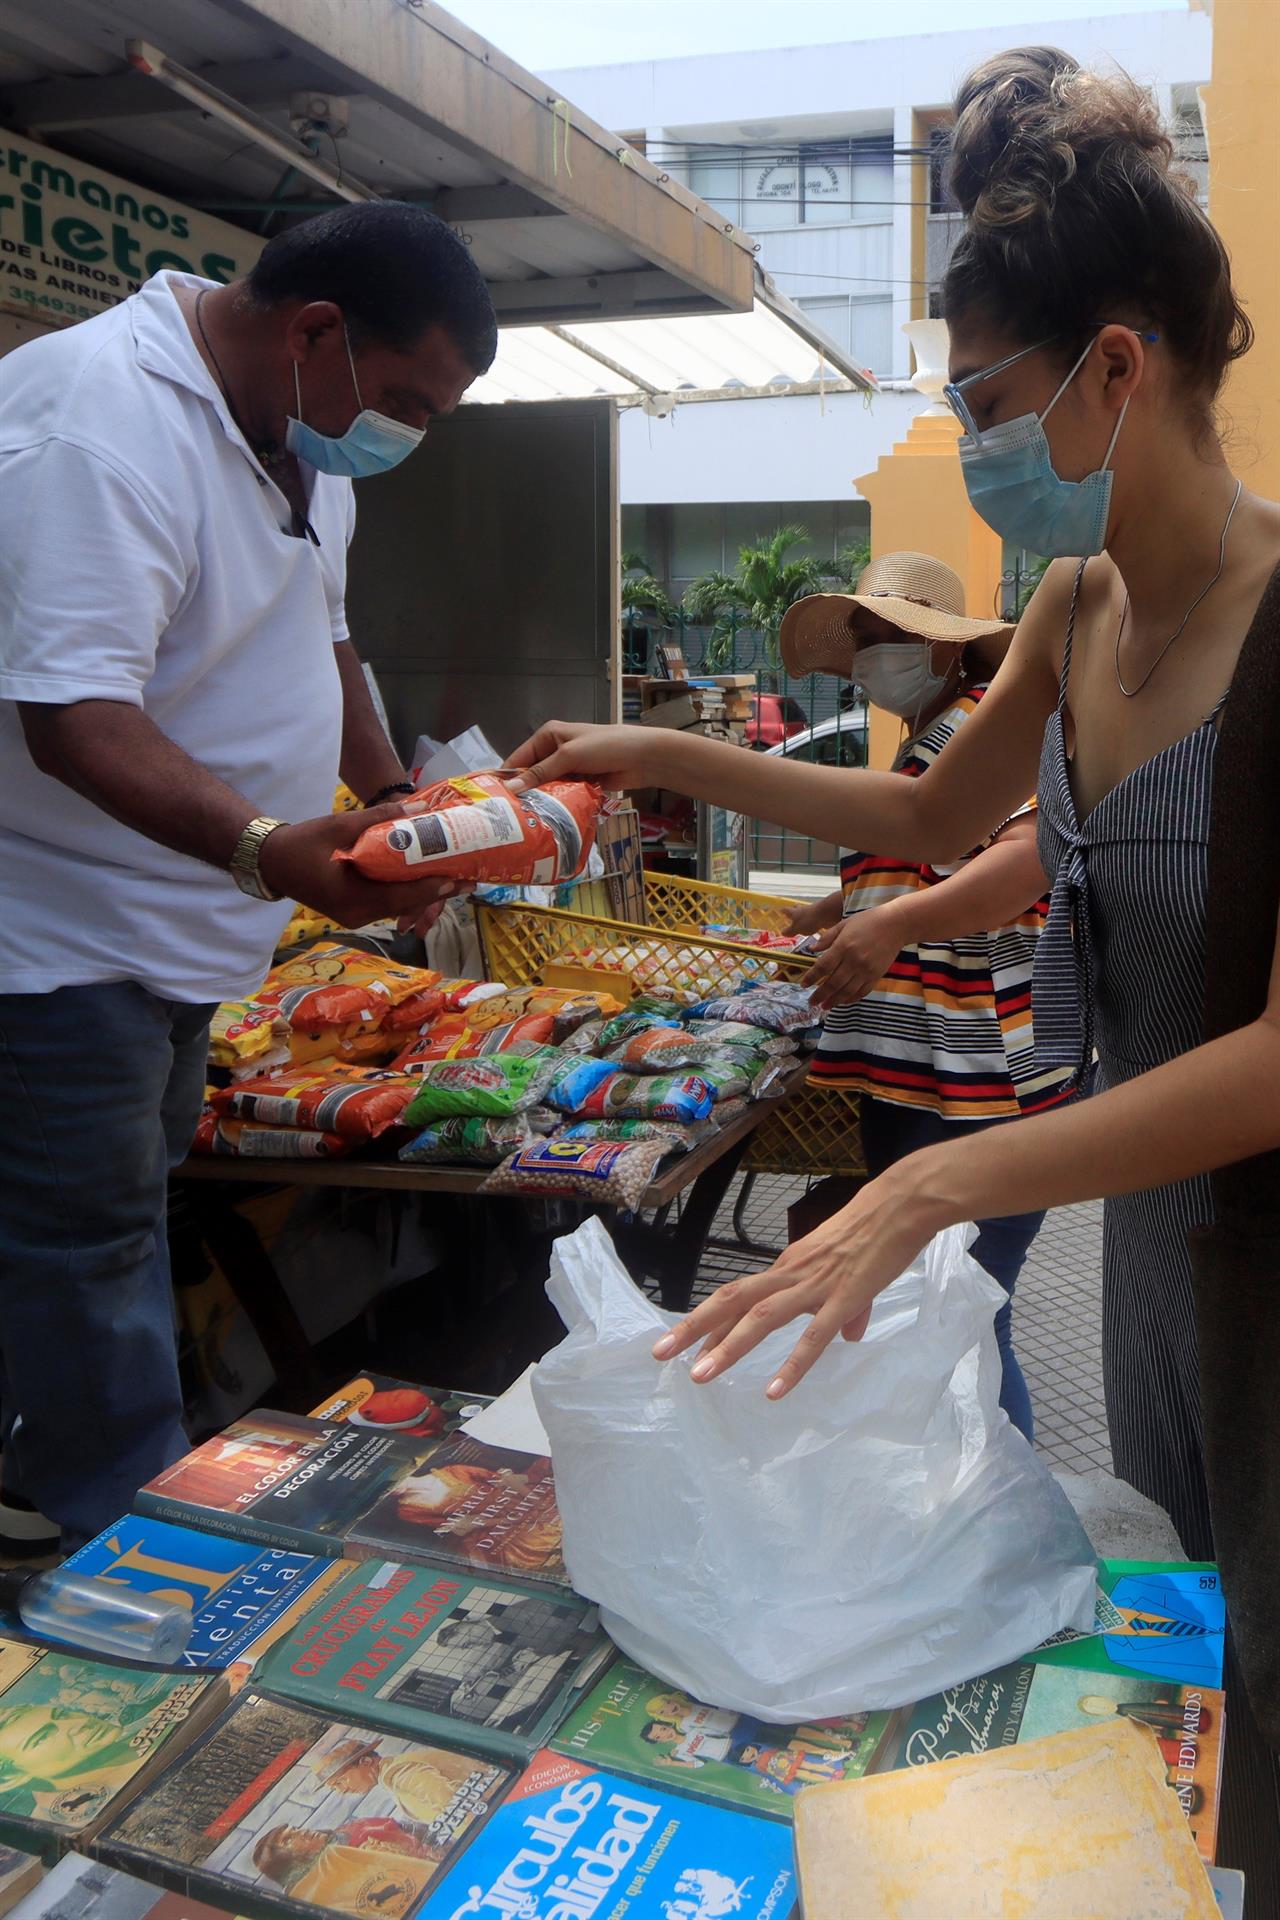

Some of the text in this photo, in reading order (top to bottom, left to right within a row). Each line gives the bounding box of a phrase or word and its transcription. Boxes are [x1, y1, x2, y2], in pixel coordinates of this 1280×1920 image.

[0, 148, 189, 239] rmanos
[1, 239, 31, 259] DE
[40, 252, 120, 288] LIBROS
[236, 1428, 339, 1506] EL COLOR EN LA
[273, 1431, 360, 1501] DECORACIÓN
[472, 1486, 516, 1529] FIRST
[476, 1475, 556, 1551] DAUGHTER
[62, 1520, 127, 1569] ROGRAMACION
[294, 1624, 319, 1646] Los
[337, 1634, 402, 1693] FRAY
[391, 1578, 463, 1641] LEJON
[370, 1617, 388, 1633] de
[1010, 1667, 1033, 1719] ABSALÓN
[1178, 1692, 1202, 1769] EDWARDS
[523, 1768, 581, 1794] ECONÓMICA
[530, 1762, 571, 1783] EDICIÓN
[428, 1770, 481, 1832] GRANDES
[520, 1793, 663, 1920] alidad
[637, 1817, 681, 1876] funcionen
[628, 1875, 647, 1897] que
